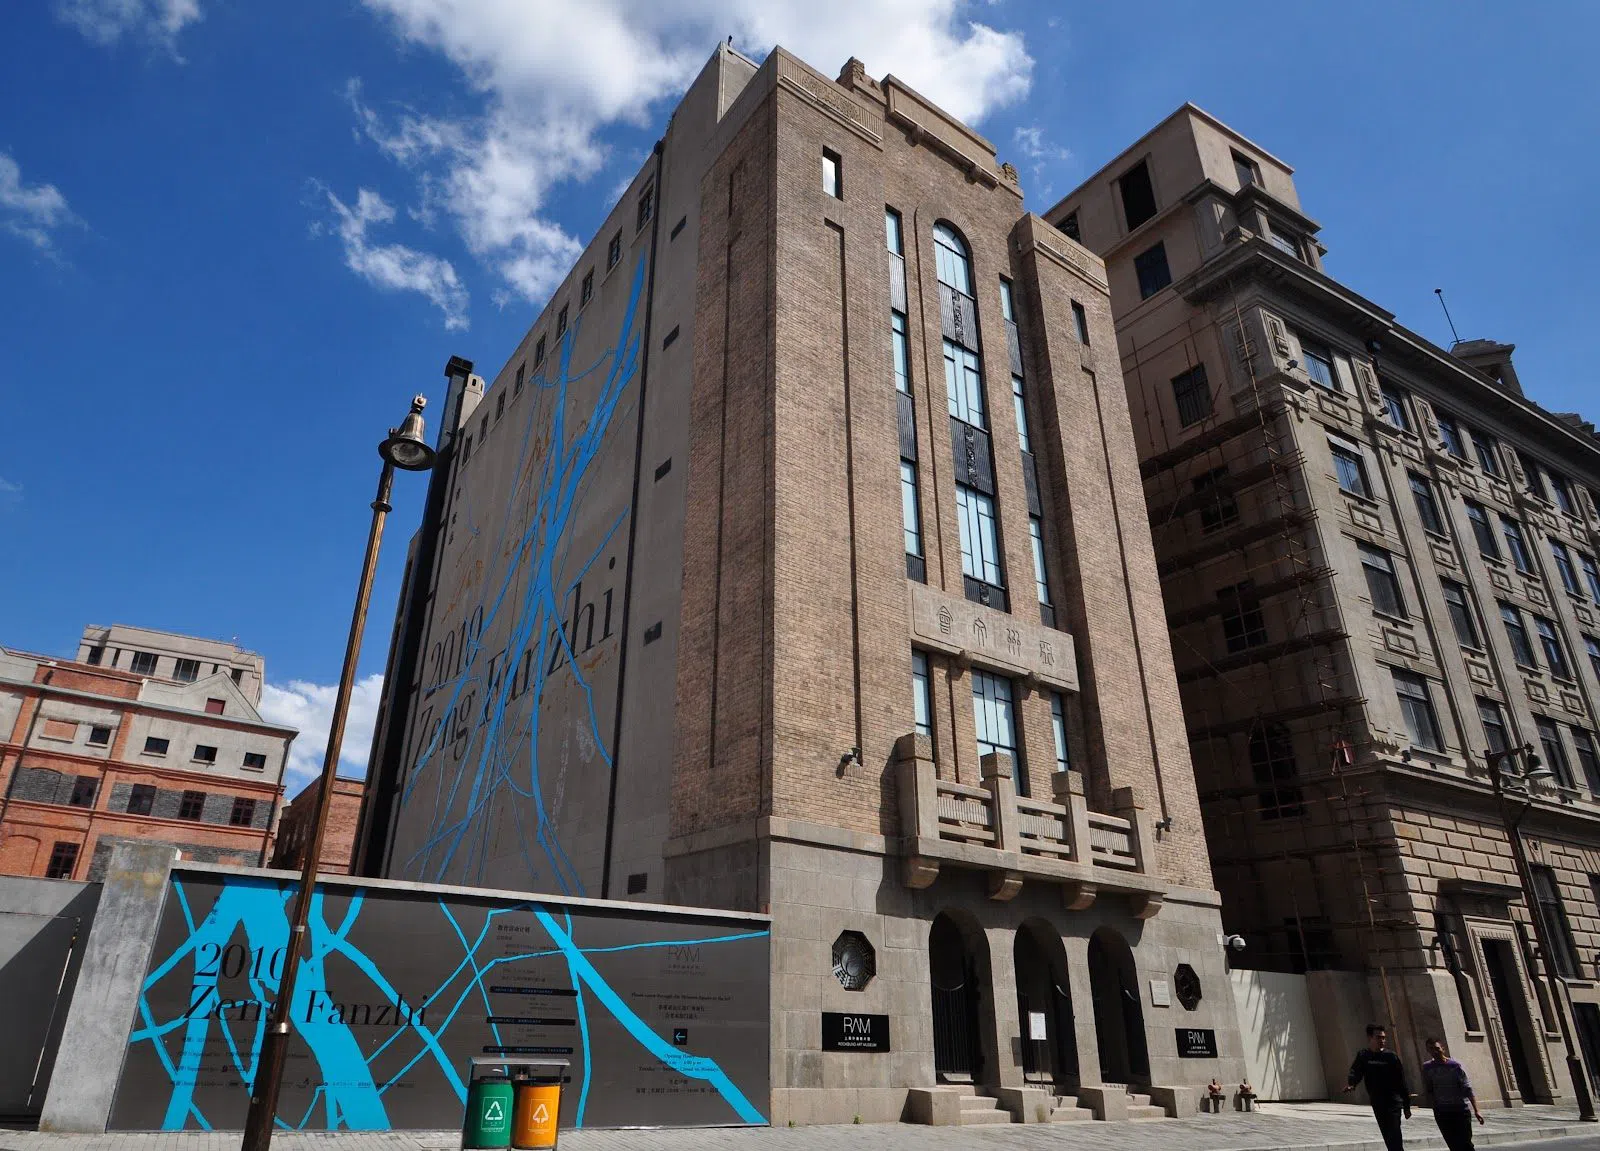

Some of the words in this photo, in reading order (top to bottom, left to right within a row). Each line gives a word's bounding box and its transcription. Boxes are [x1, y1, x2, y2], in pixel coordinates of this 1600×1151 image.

[301, 989, 428, 1026] Fanzhi
[843, 1016, 871, 1034] RAM
[1187, 1031, 1206, 1044] RAM
